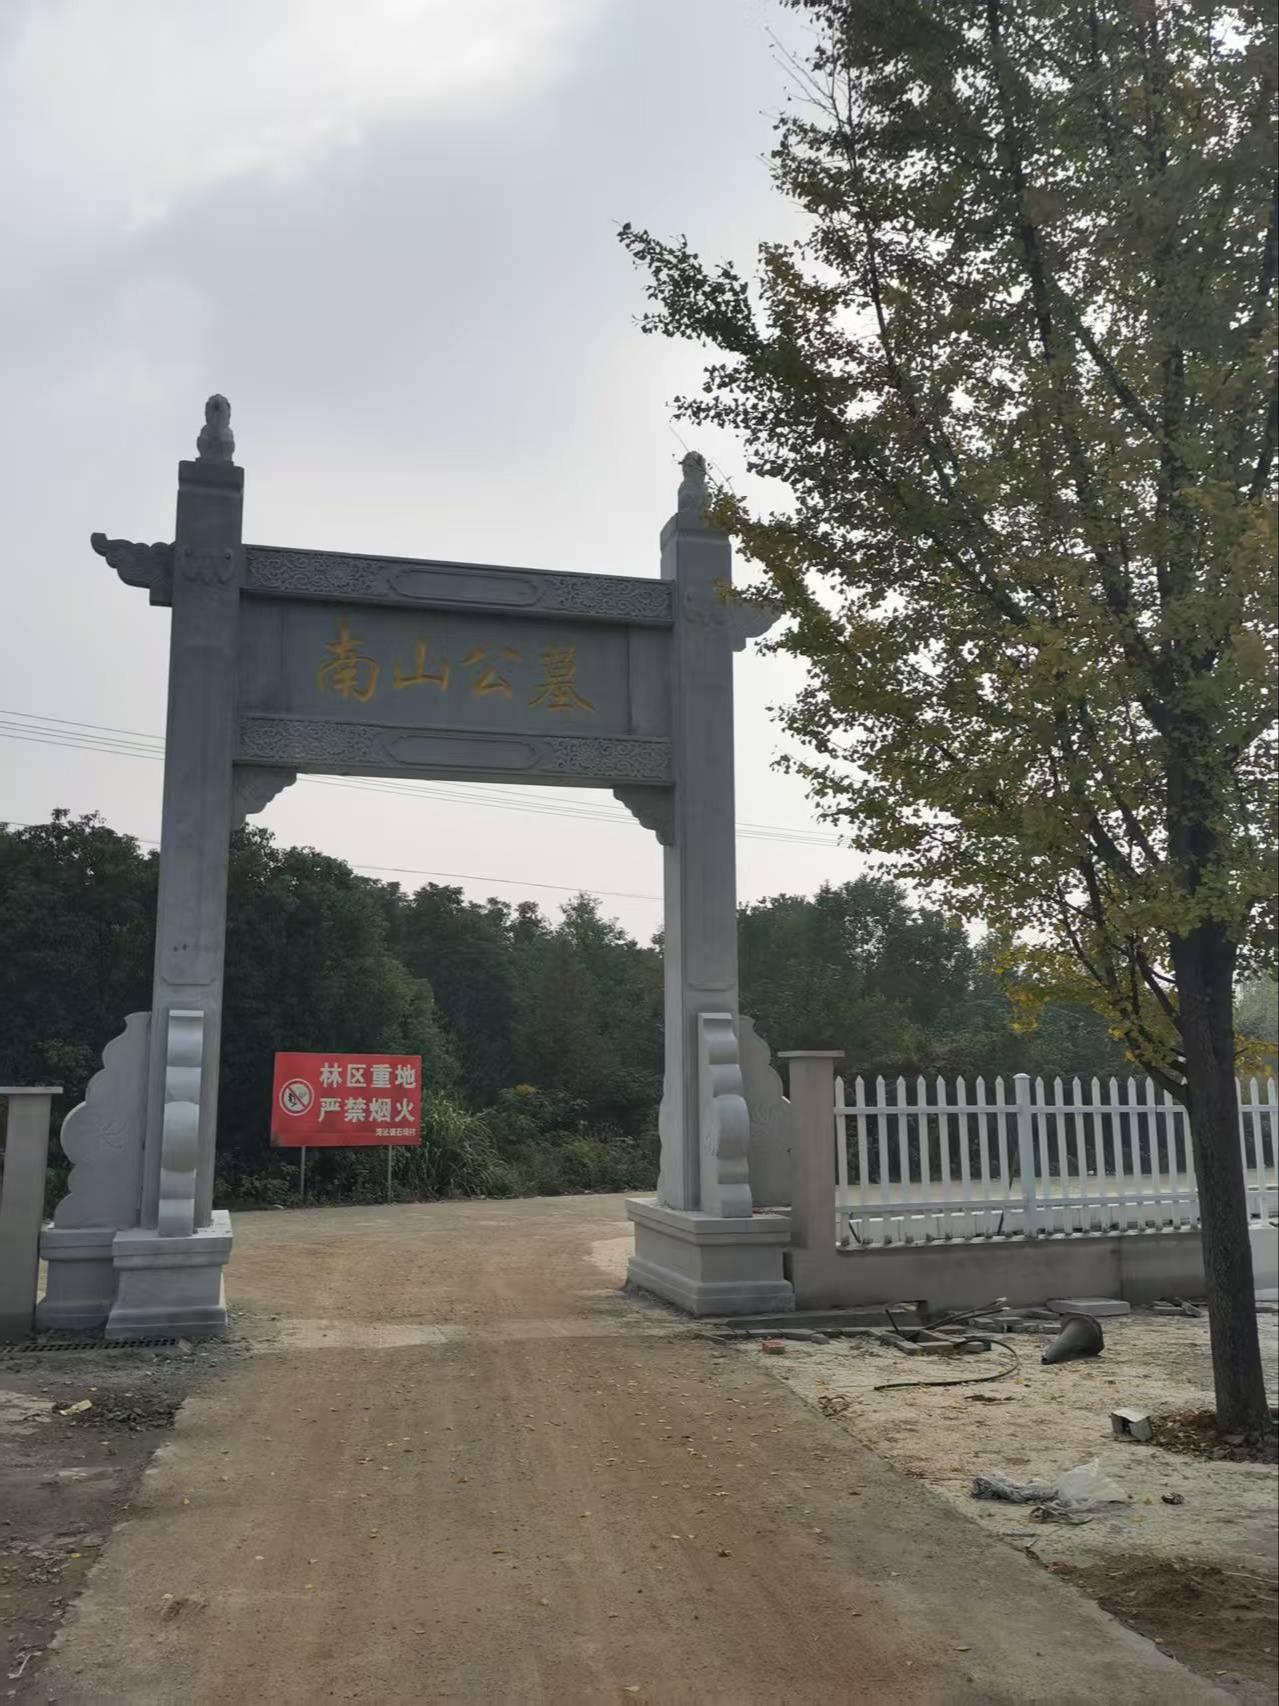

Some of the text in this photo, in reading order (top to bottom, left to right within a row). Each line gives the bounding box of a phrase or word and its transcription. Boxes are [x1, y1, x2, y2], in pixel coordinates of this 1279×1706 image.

[317, 627, 592, 711] 南山公墓
[320, 1062, 417, 1088] 林区重地
[318, 1097, 415, 1122] 严禁烟火
